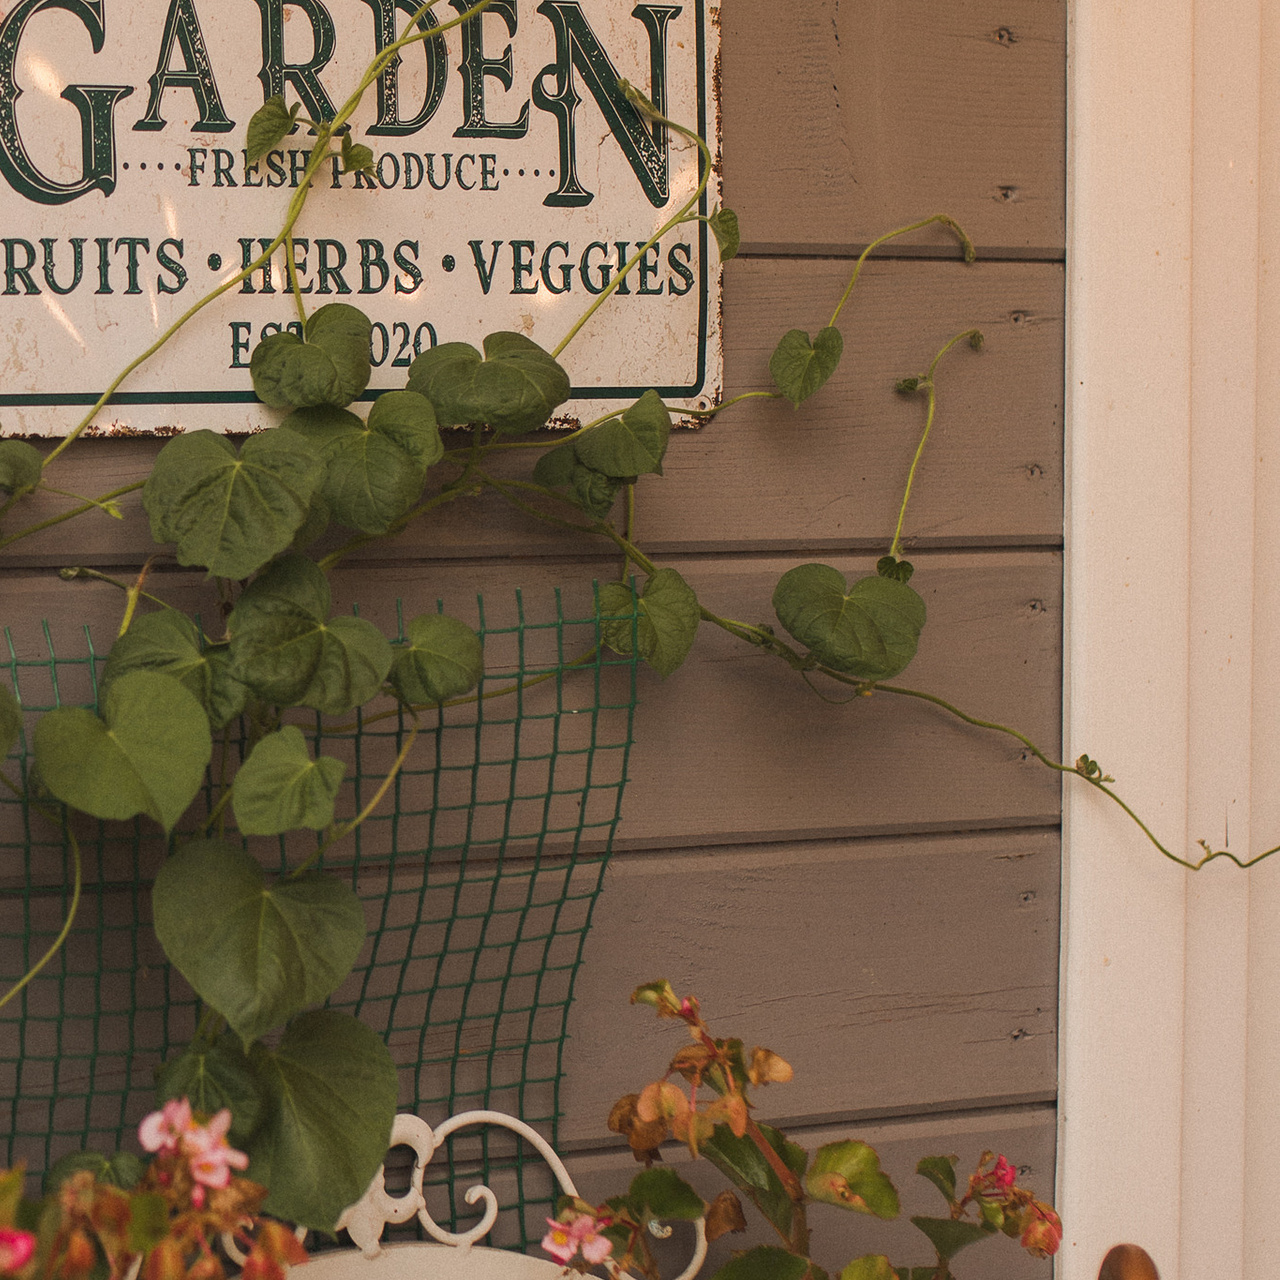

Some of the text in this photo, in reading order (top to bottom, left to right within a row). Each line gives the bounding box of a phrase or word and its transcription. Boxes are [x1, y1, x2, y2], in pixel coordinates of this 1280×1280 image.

[187, 148, 313, 188] FRESH
[237, 237, 423, 296] HERBS
[467, 239, 695, 297] VEGGIES
